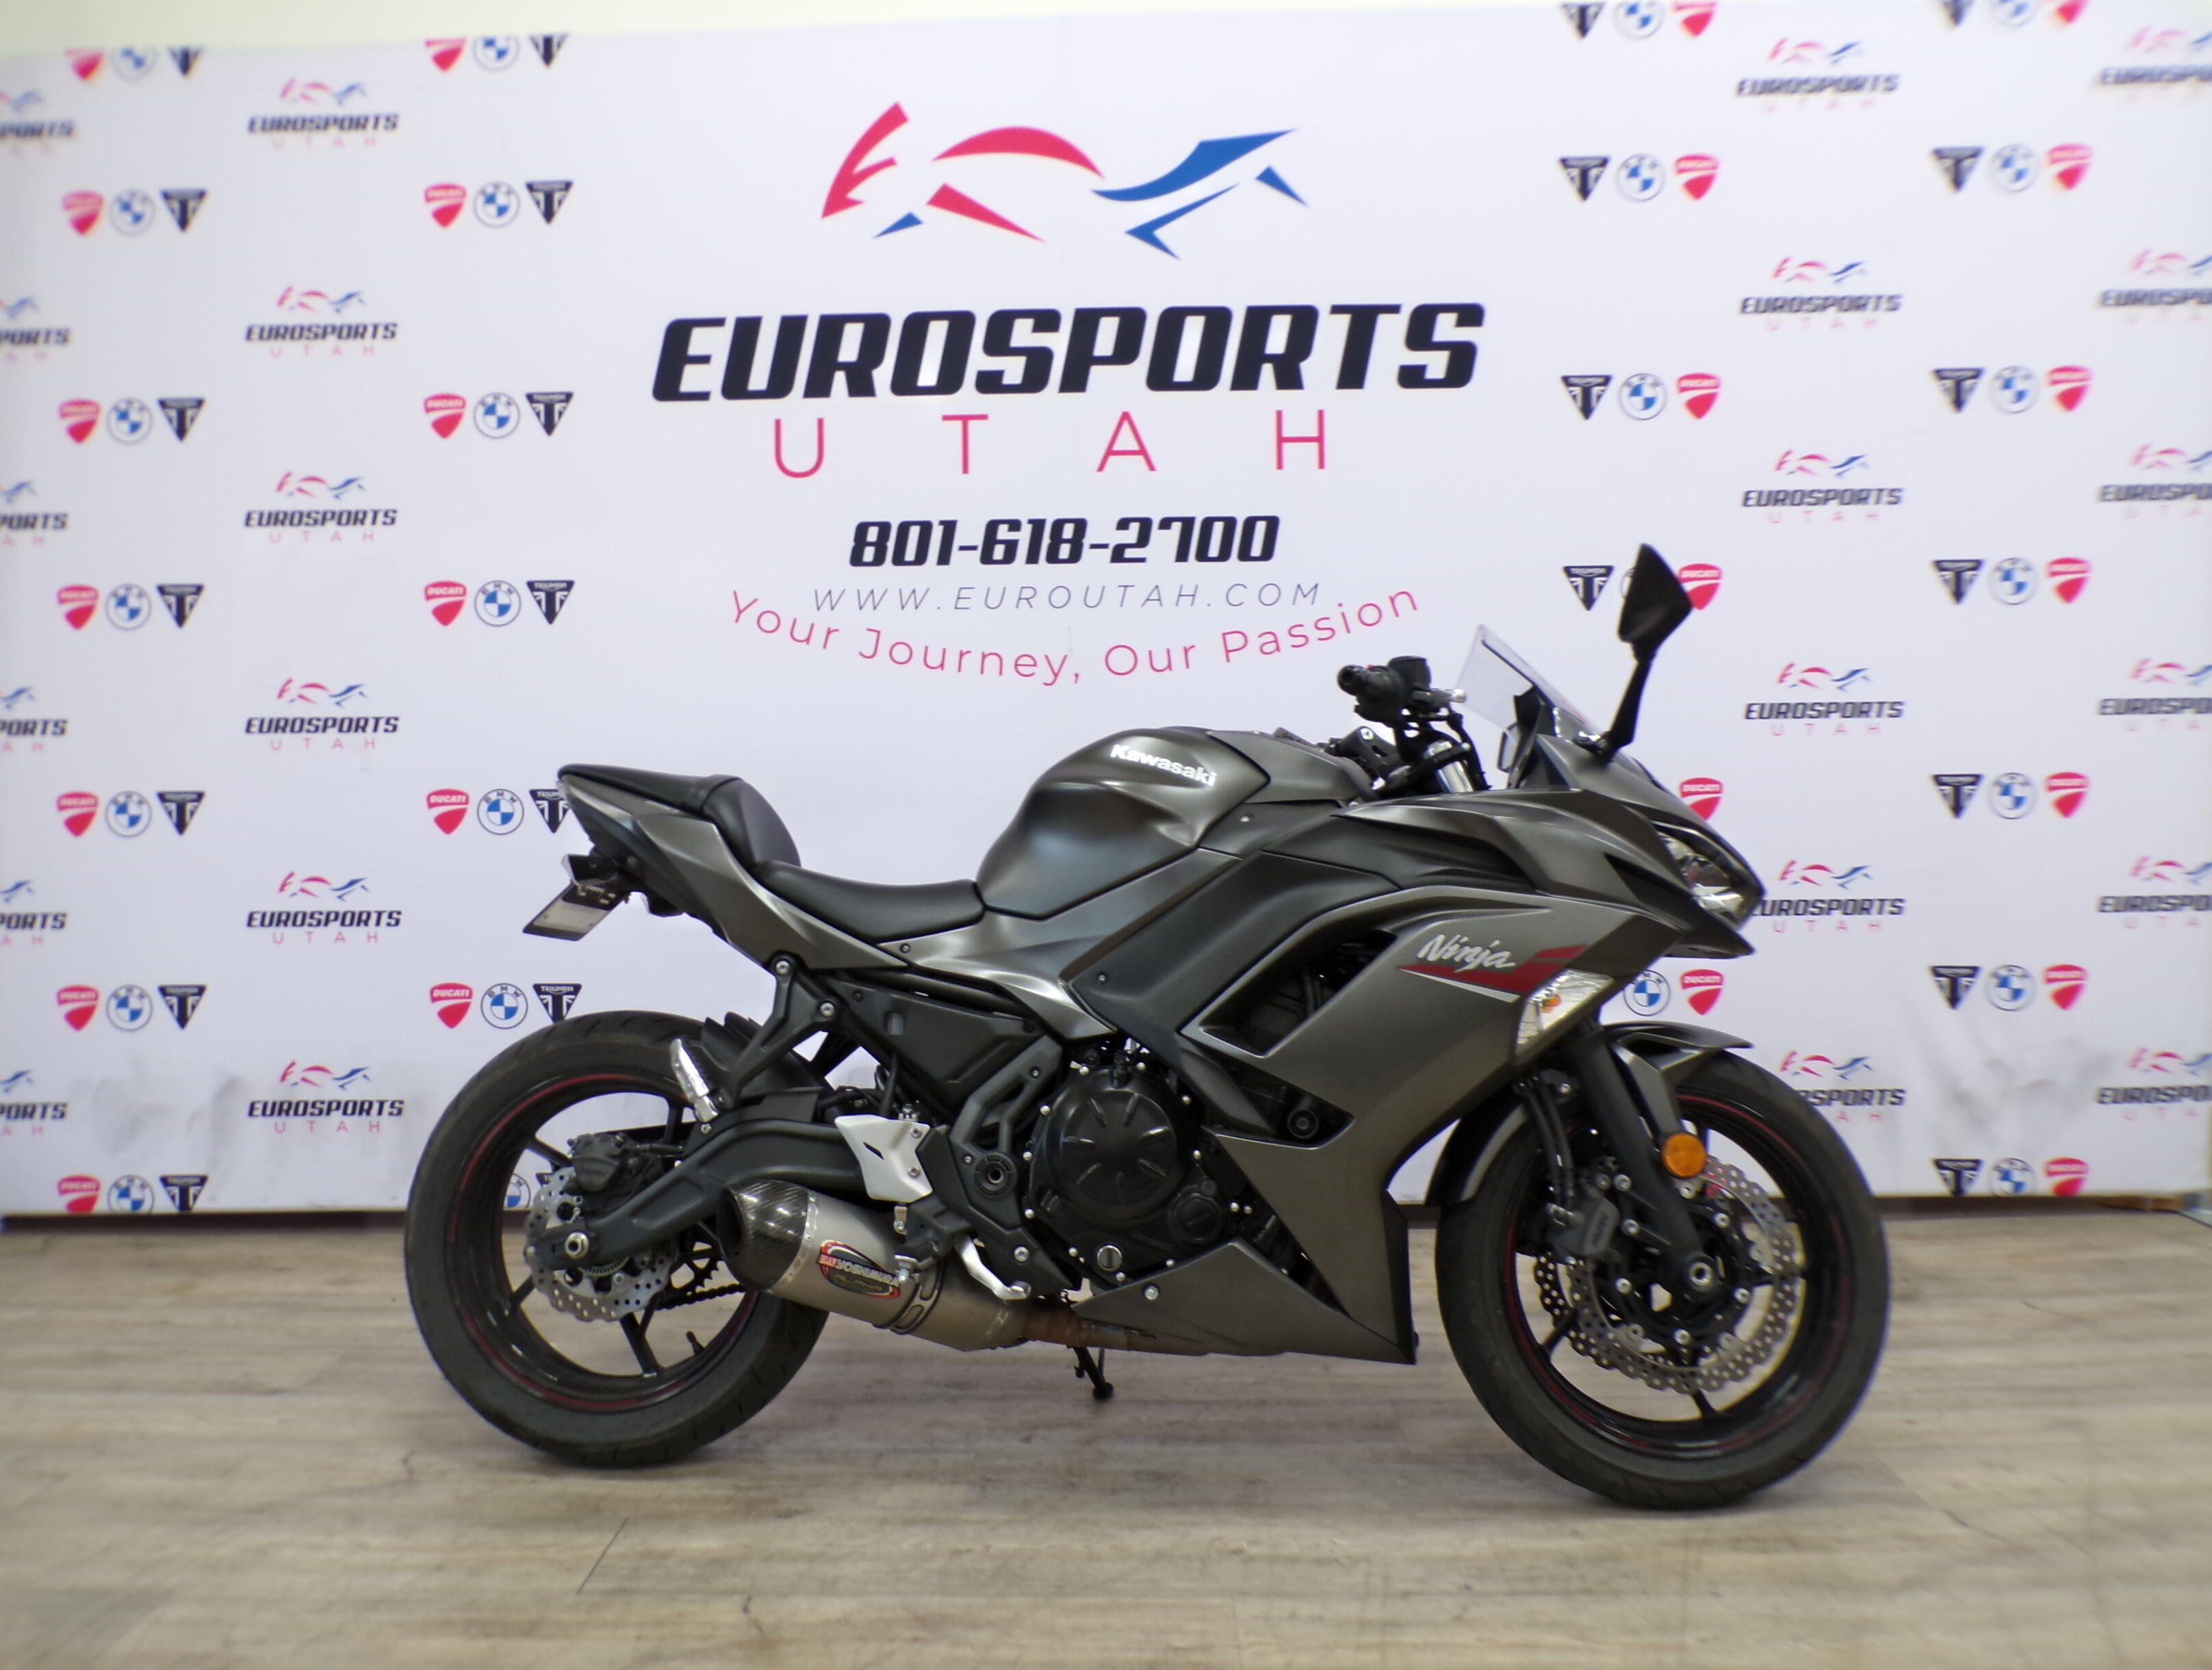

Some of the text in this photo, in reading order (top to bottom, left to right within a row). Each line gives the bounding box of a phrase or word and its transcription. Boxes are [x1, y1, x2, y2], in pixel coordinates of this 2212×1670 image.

[248, 114, 399, 133] EUROSPORTS
[1740, 294, 1902, 315] EUROSPORTS
[246, 322, 398, 342] EUROSPORTS
[652, 302, 1485, 402] EUROSPORTS
[773, 409, 1326, 478] UTAH
[1742, 487, 1903, 507] EUROSPORTS
[245, 509, 398, 528] EUROSPORTS
[849, 515, 1280, 567] 801-618-2700
[427, 587, 464, 595] DUCATI
[813, 582, 1320, 611] WWW.EUROUTAH.COM
[732, 589, 1418, 686] Your Journey, Our Passion
[1745, 700, 1904, 720] EUROSPORTS
[245, 716, 400, 734] EUROSPORTS
[1109, 743, 1218, 787] Kawasaki
[430, 795, 467, 804] DUCATI
[246, 910, 402, 928] EUROSPORTS
[272, 931, 380, 945] UTAH
[1416, 934, 1517, 973] Ninja
[435, 989, 471, 998] DUCATI
[248, 1100, 405, 1118] EUROSPORTS
[274, 1120, 382, 1134] UTAH
